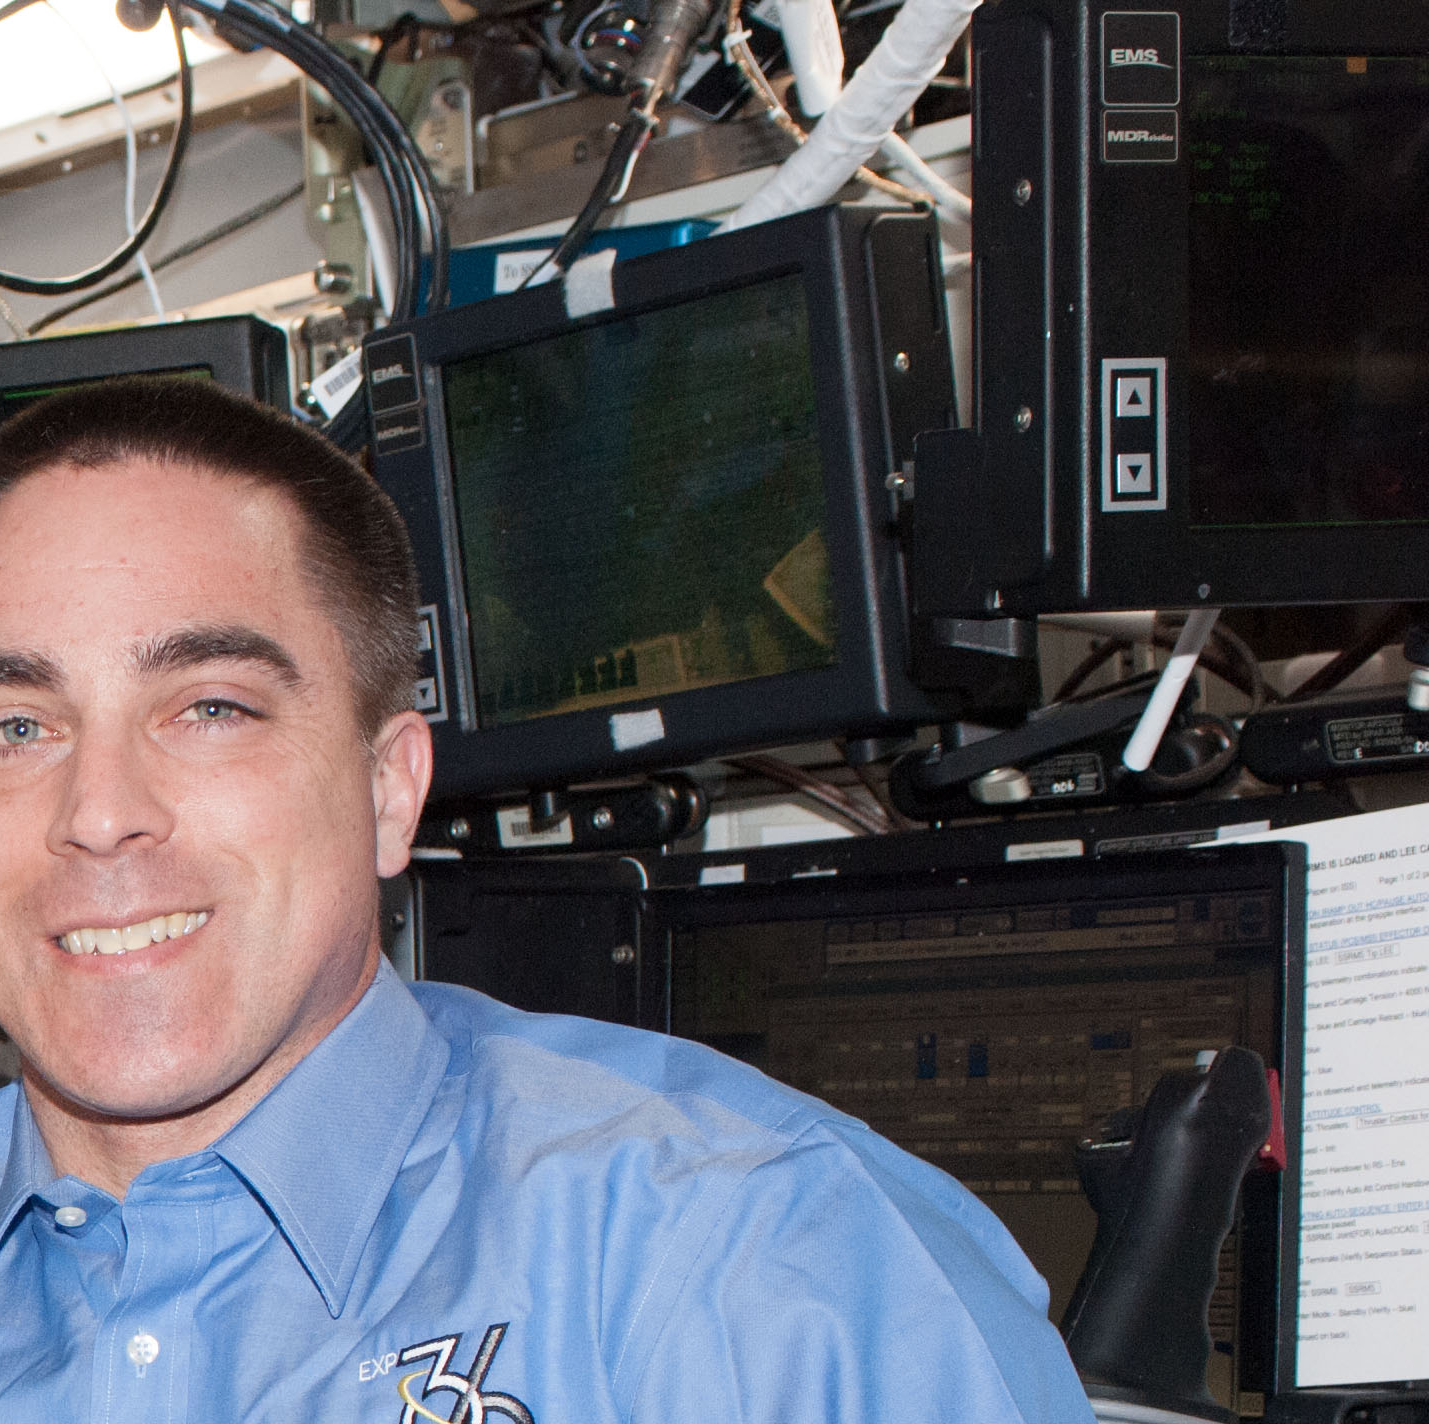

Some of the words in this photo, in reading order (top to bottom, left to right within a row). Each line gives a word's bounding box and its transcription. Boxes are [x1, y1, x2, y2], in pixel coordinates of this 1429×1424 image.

[1111, 48, 1158, 64] EMS
[372, 364, 404, 383] EMS
[1339, 852, 1377, 868] LOADED
[1378, 849, 1398, 860] AND
[1400, 845, 1417, 857] LEE
[358, 1351, 399, 1383] EXP
